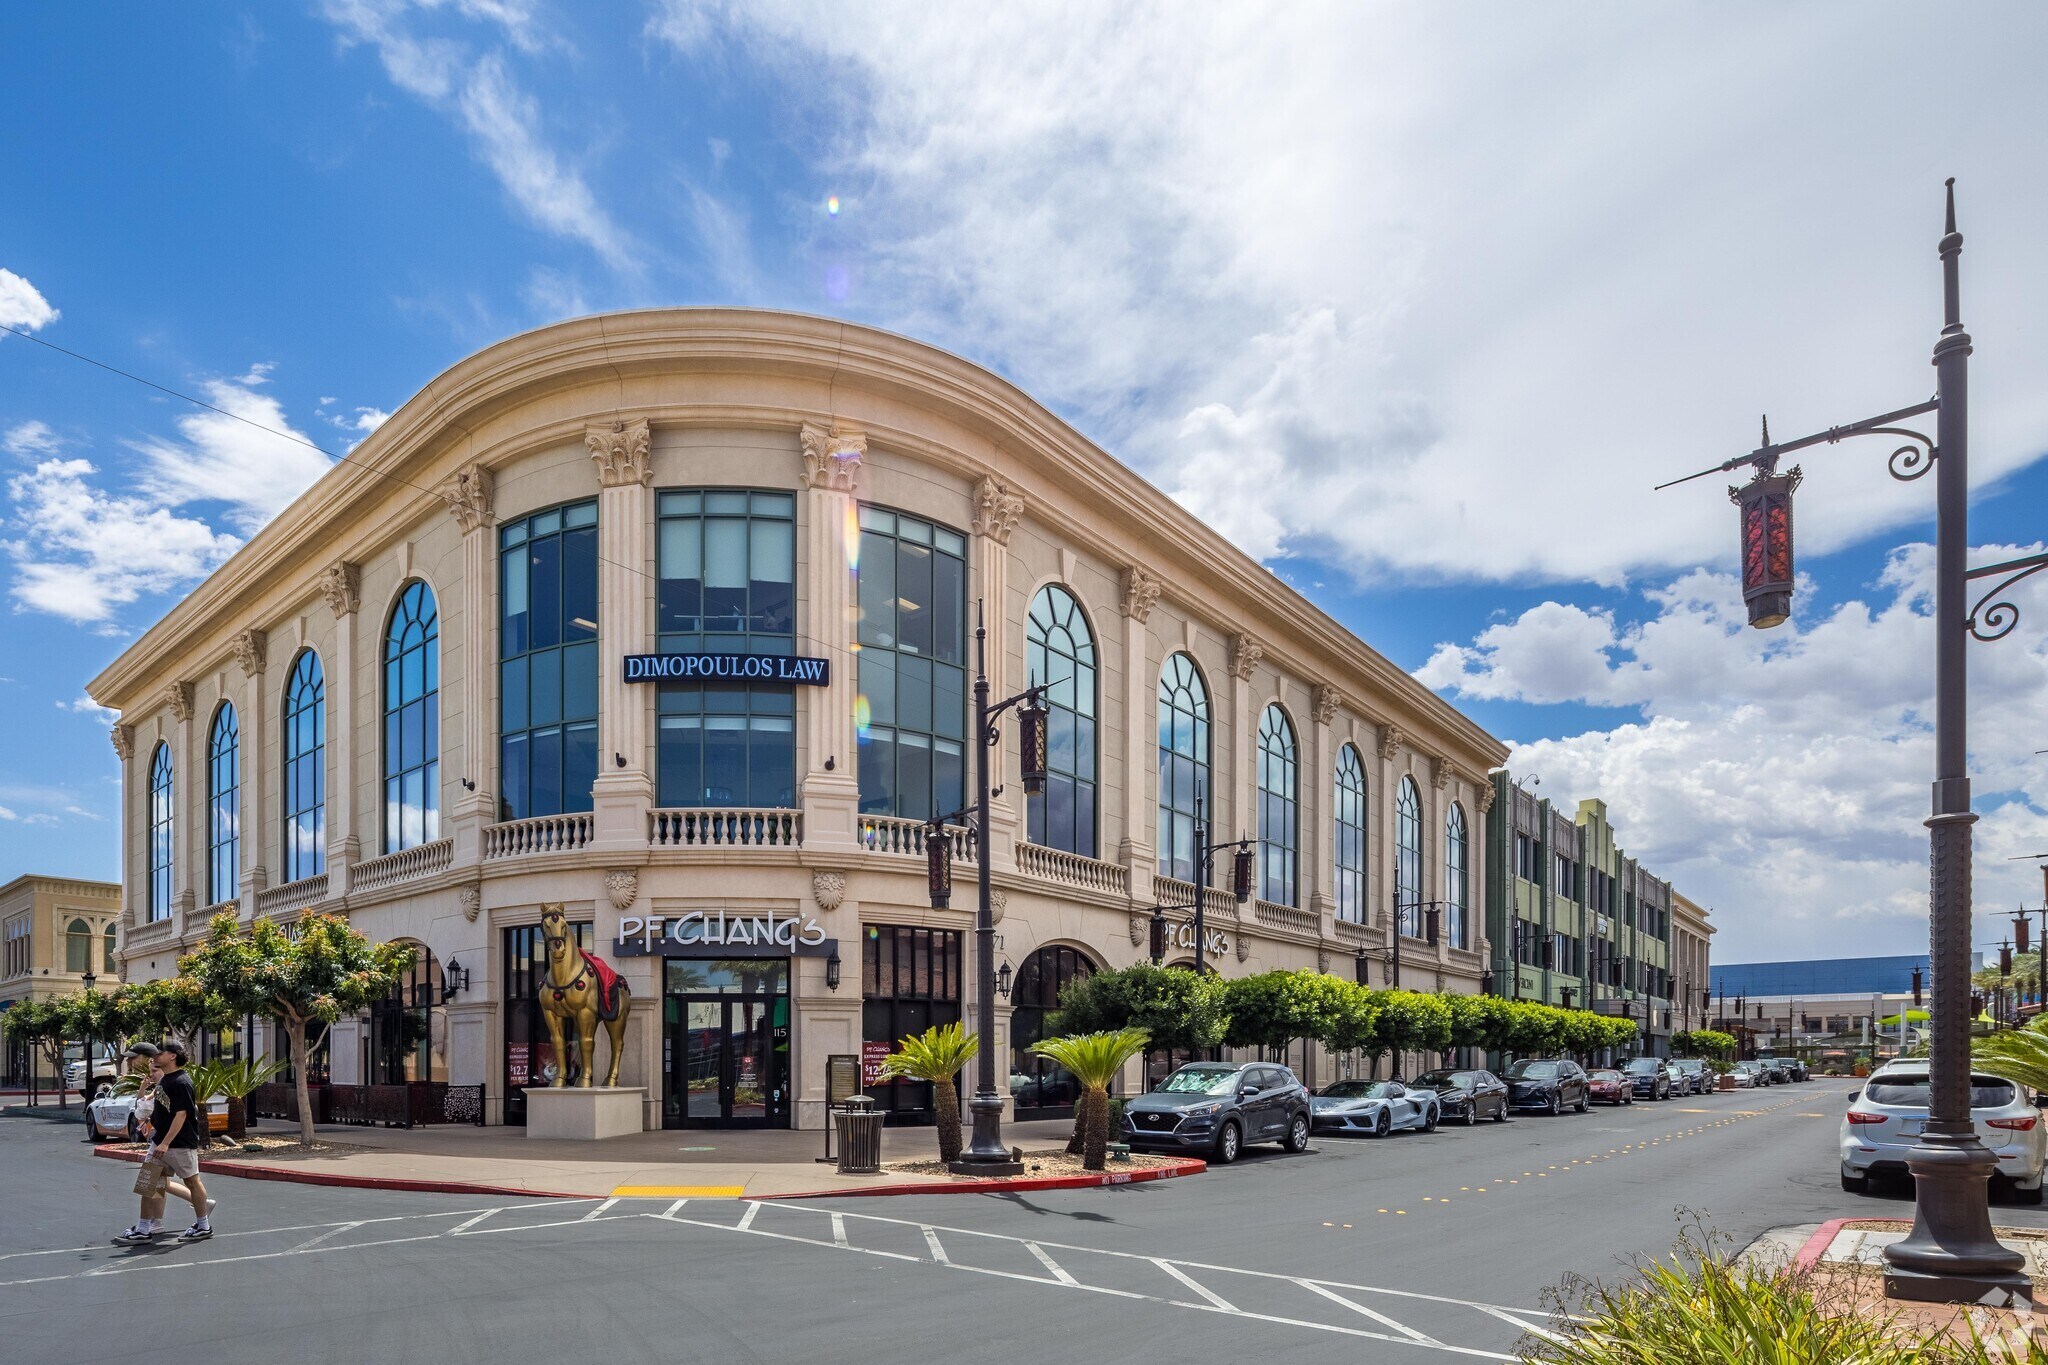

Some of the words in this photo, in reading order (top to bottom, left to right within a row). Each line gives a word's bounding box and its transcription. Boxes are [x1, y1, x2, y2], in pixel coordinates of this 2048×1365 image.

[627, 656, 773, 678] DIMOPOULOS
[778, 658, 825, 681] LAW
[619, 915, 667, 953] P.F.
[673, 910, 827, 954] CHANG'S
[1178, 923, 1230, 959] CHNG'S
[773, 1028, 787, 1038] 115
[1102, 1177, 1110, 1185] NO
[1112, 1174, 1131, 1184] PARKING
